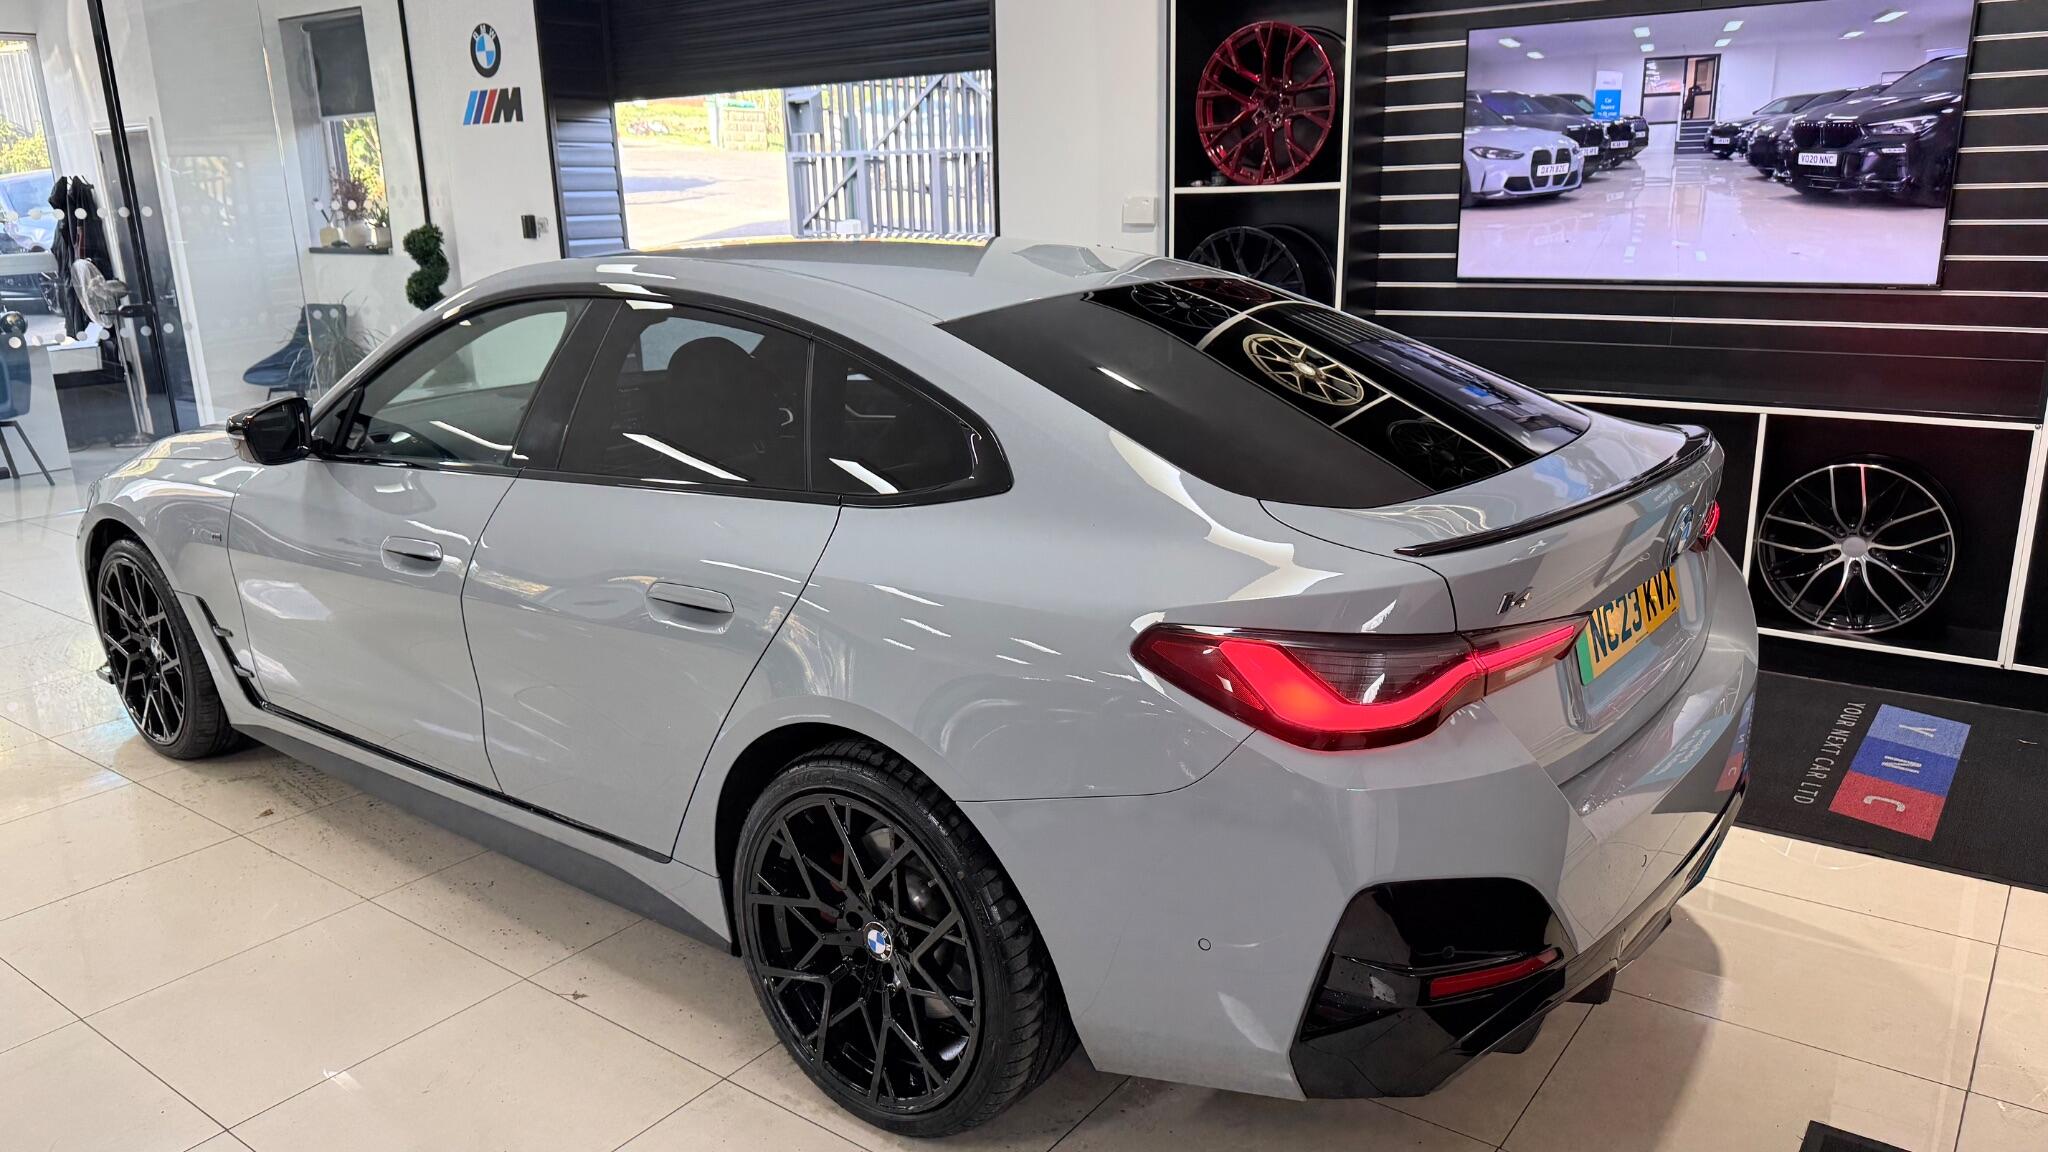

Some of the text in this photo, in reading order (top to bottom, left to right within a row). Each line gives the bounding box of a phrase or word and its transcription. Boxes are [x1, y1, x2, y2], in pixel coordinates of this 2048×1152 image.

[472, 24, 497, 40] BMW
[1588, 566, 1677, 663] NC23 KVX
[1793, 701, 1867, 805] YOUR NEXT CAR LTD
